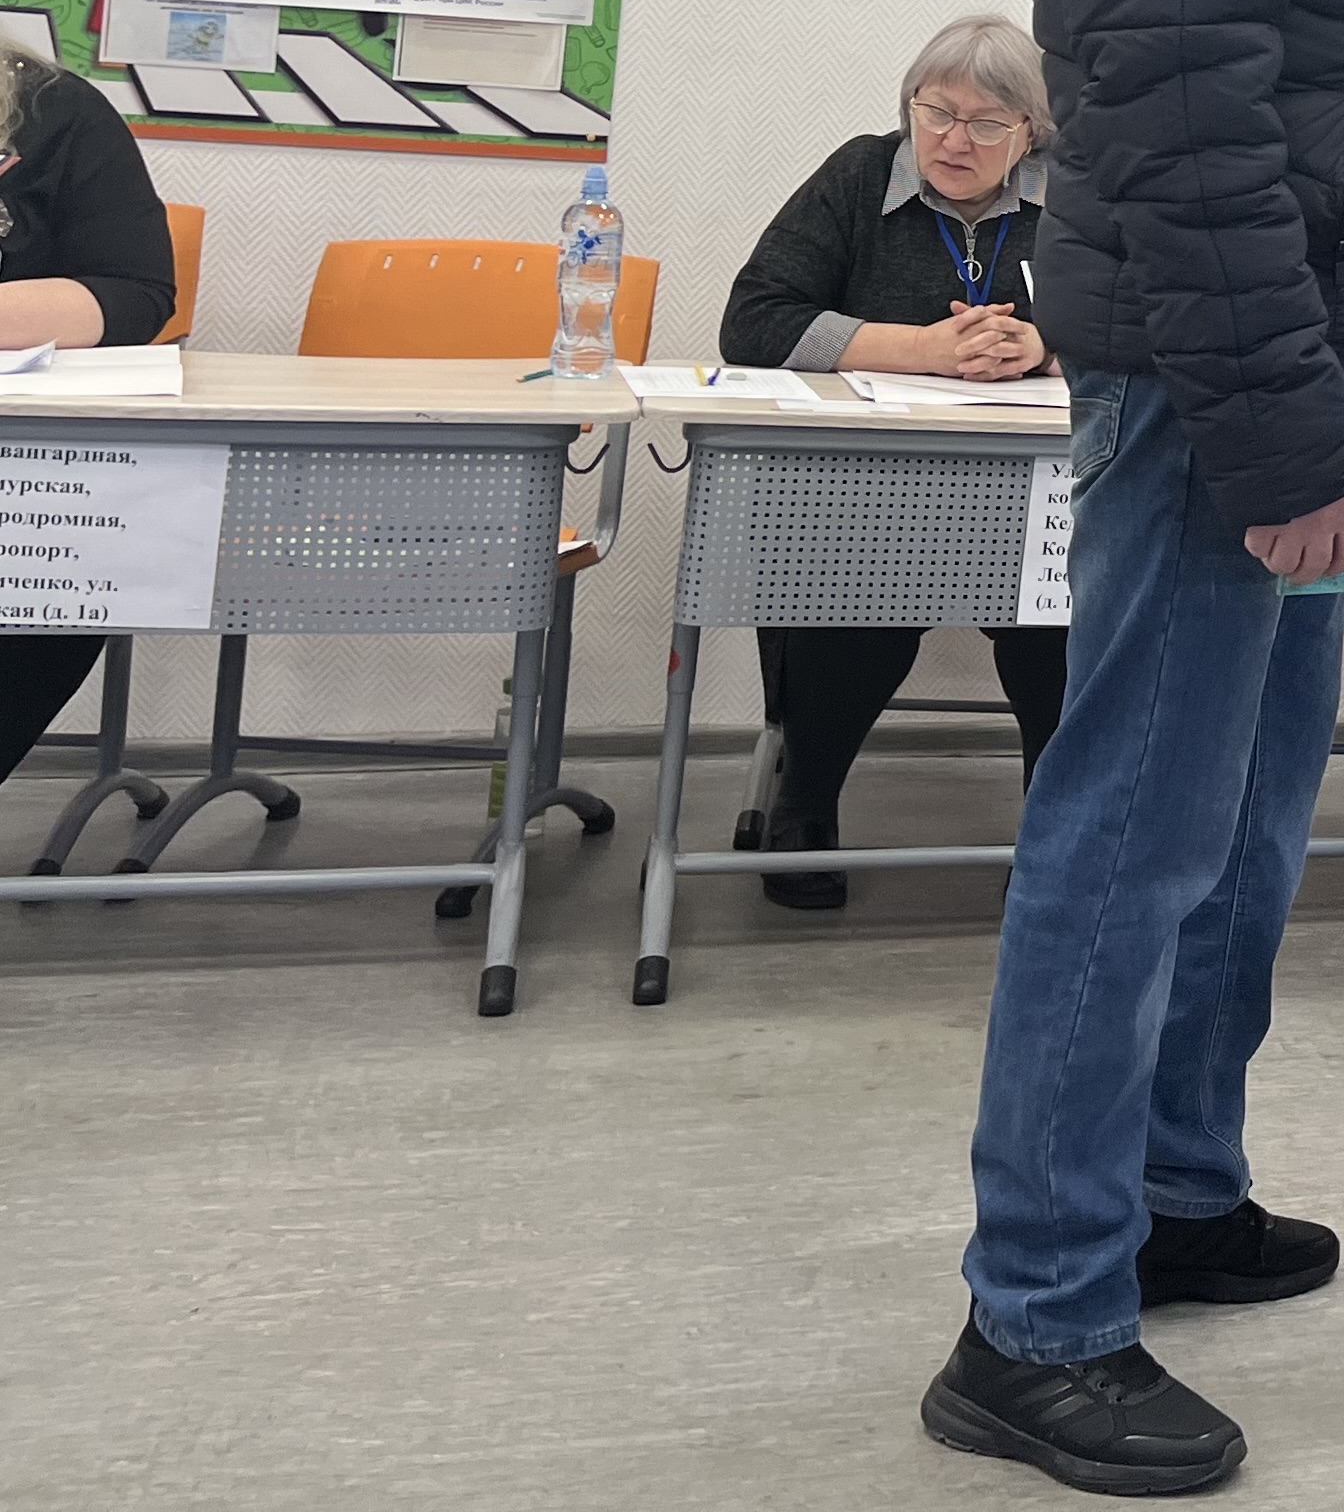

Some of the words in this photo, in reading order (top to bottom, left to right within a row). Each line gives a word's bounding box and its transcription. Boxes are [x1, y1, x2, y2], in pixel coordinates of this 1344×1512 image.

[86, 578, 119, 596] ул.
[1036, 594, 1057, 611] (д.
[43, 603, 68, 622] (д.
[78, 604, 109, 623] 1а)
